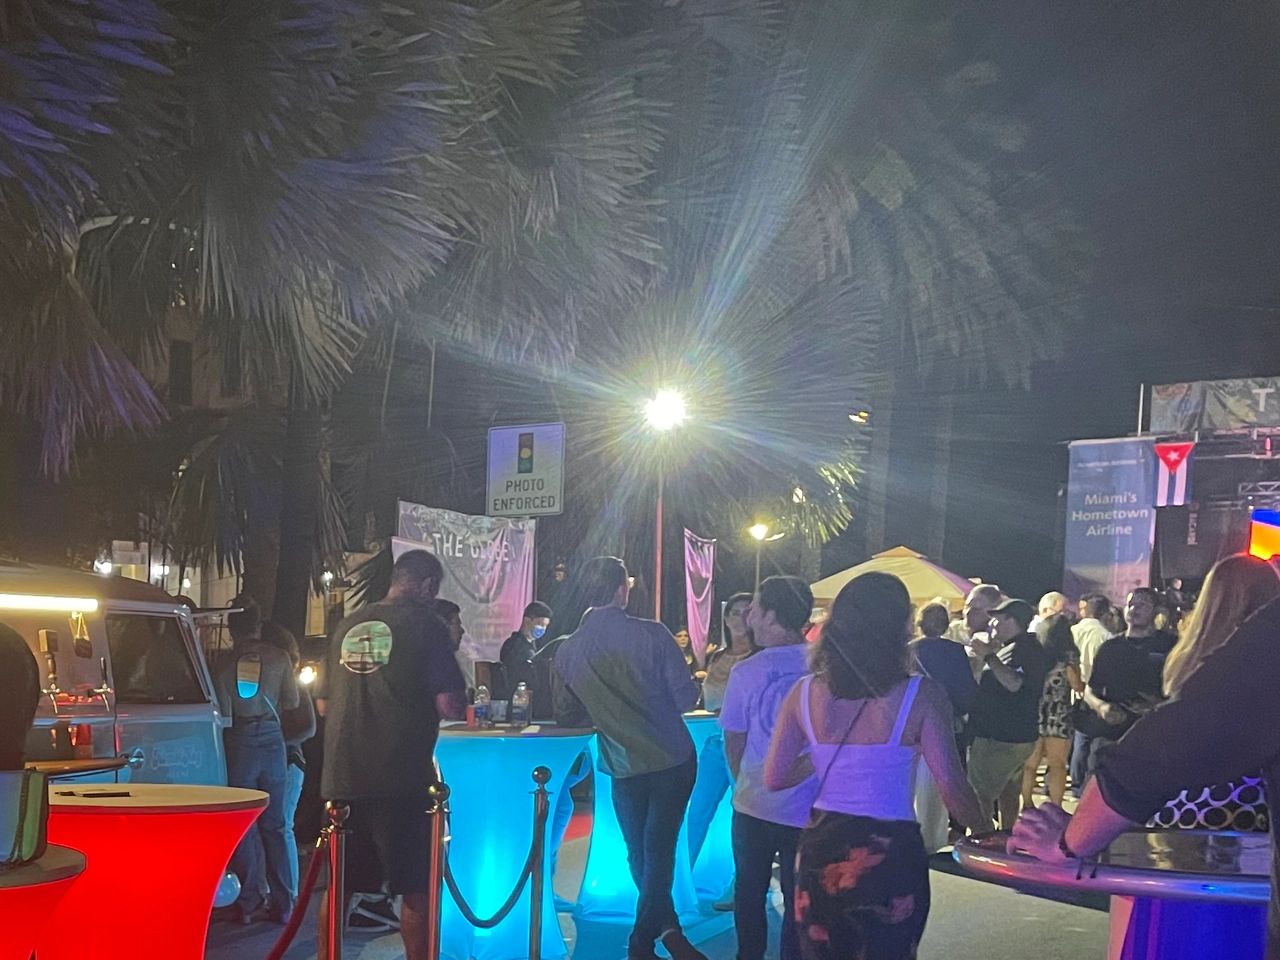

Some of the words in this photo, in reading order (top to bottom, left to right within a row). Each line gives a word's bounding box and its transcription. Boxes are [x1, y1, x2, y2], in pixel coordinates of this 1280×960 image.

[506, 478, 544, 493] PHOTO
[493, 495, 555, 511] ENFORCED
[1084, 491, 1137, 505] Miami's
[1072, 508, 1149, 521] Hometown
[1086, 524, 1133, 537] Airline
[432, 532, 464, 558] THE
